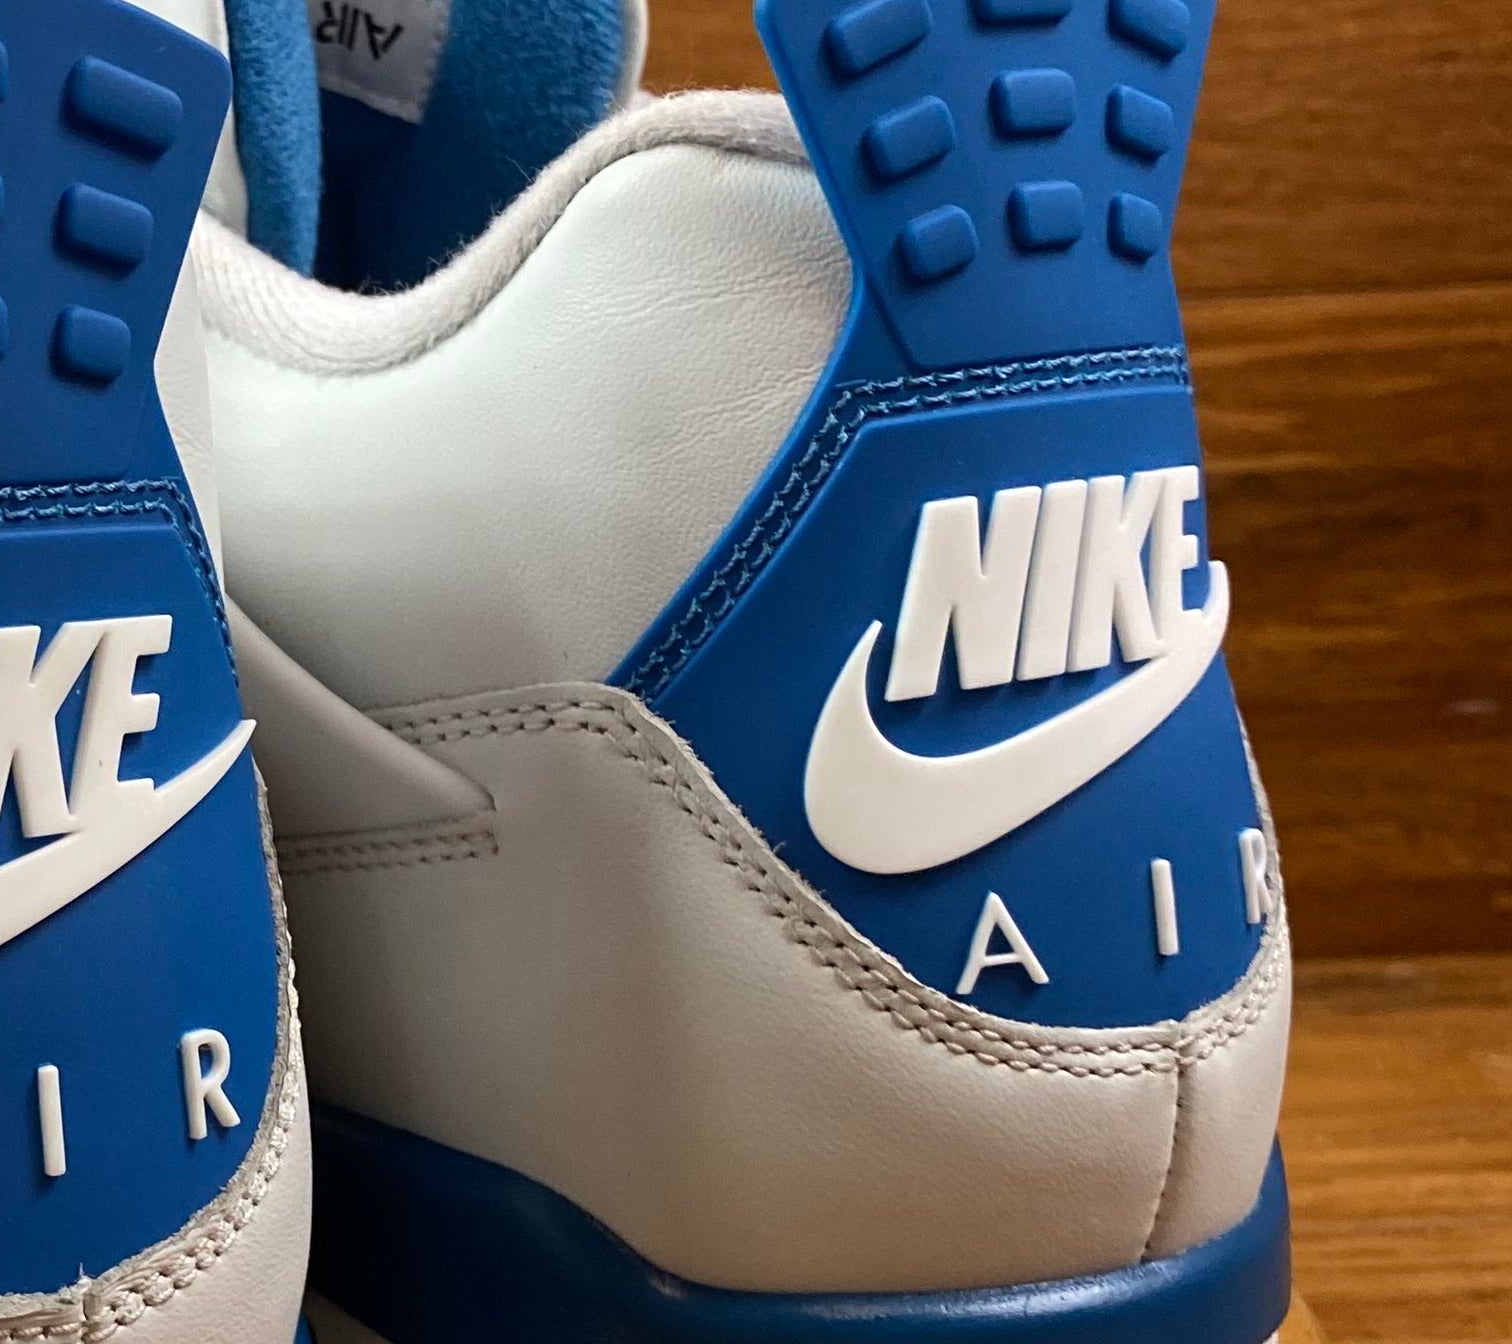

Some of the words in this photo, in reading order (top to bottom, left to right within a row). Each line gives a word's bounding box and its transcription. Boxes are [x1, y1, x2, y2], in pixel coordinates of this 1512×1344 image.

[315, 0, 404, 61] AIR
[884, 465, 1204, 702] NIKE
[955, 827, 1275, 996] AIR
